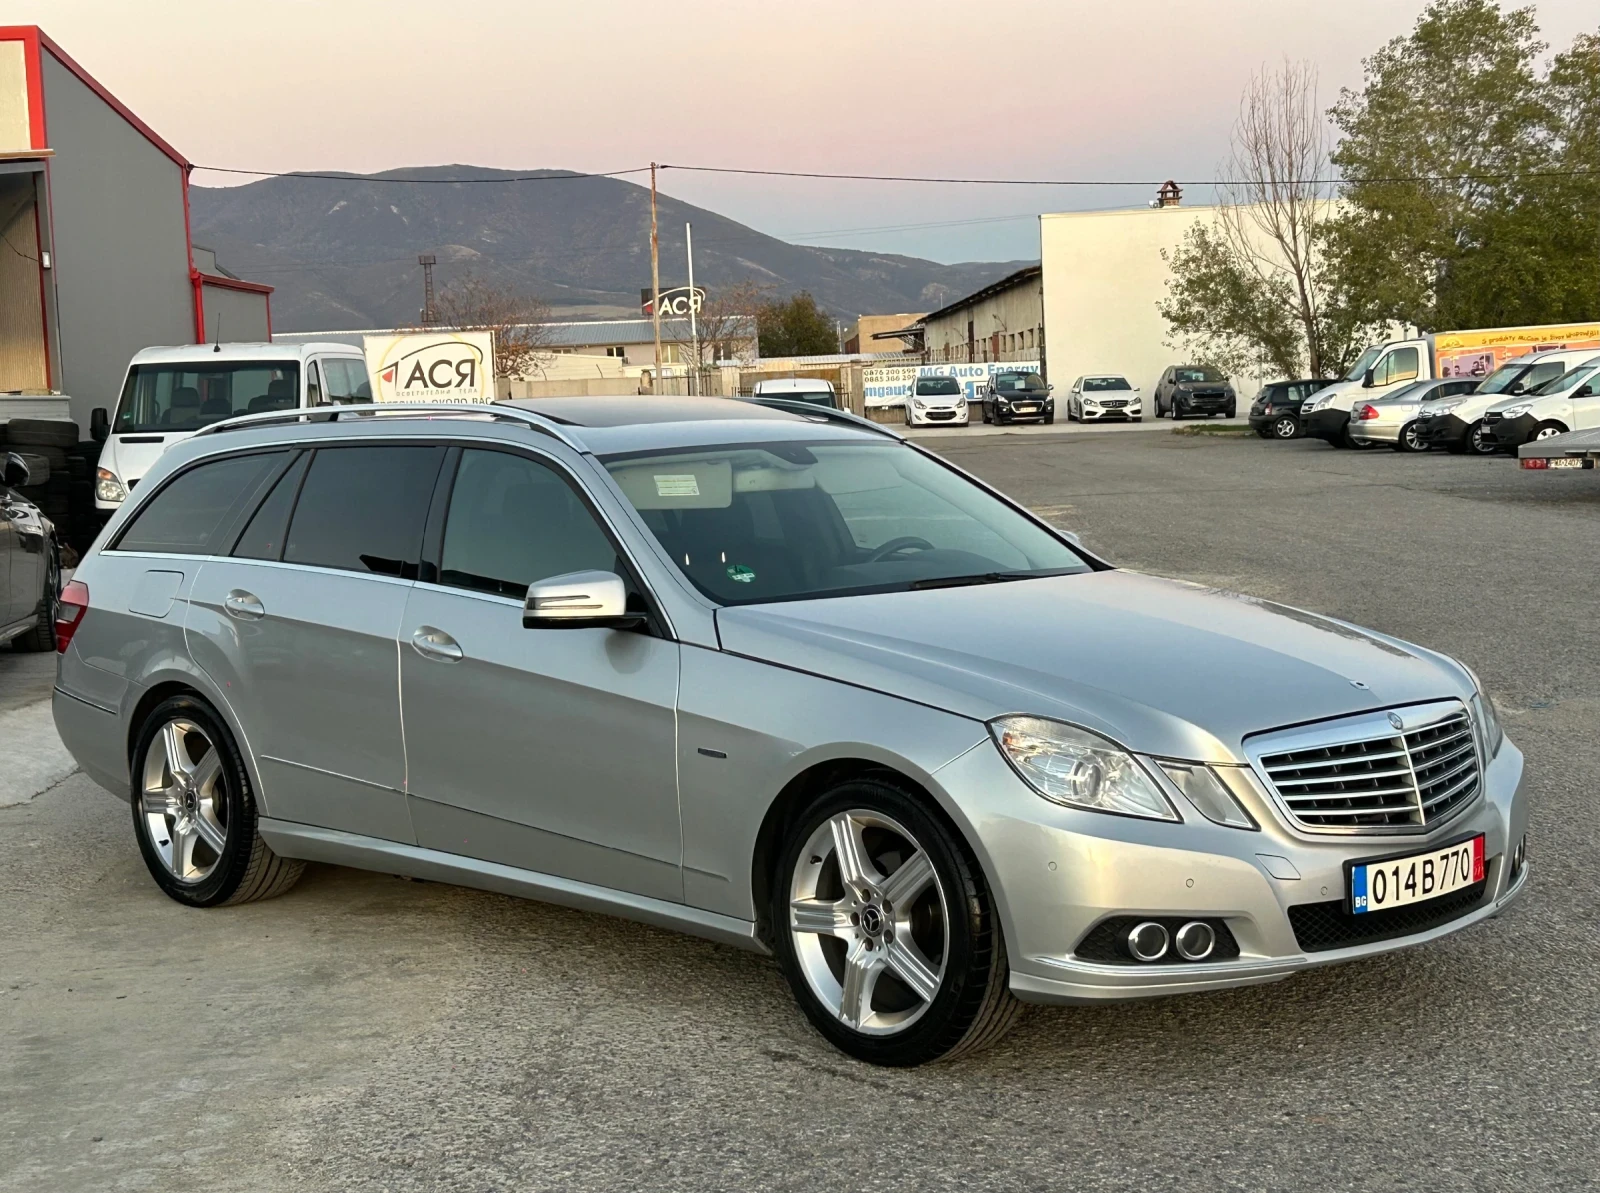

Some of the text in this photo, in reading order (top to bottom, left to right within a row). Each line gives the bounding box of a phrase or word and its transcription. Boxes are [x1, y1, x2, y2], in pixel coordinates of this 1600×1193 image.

[404, 359, 476, 389] АСЯ
[920, 363, 1039, 378] MG Auto Energy
[864, 384, 907, 398] mgaut
[1373, 847, 1470, 904] 014B770
[1355, 896, 1367, 907] BG
